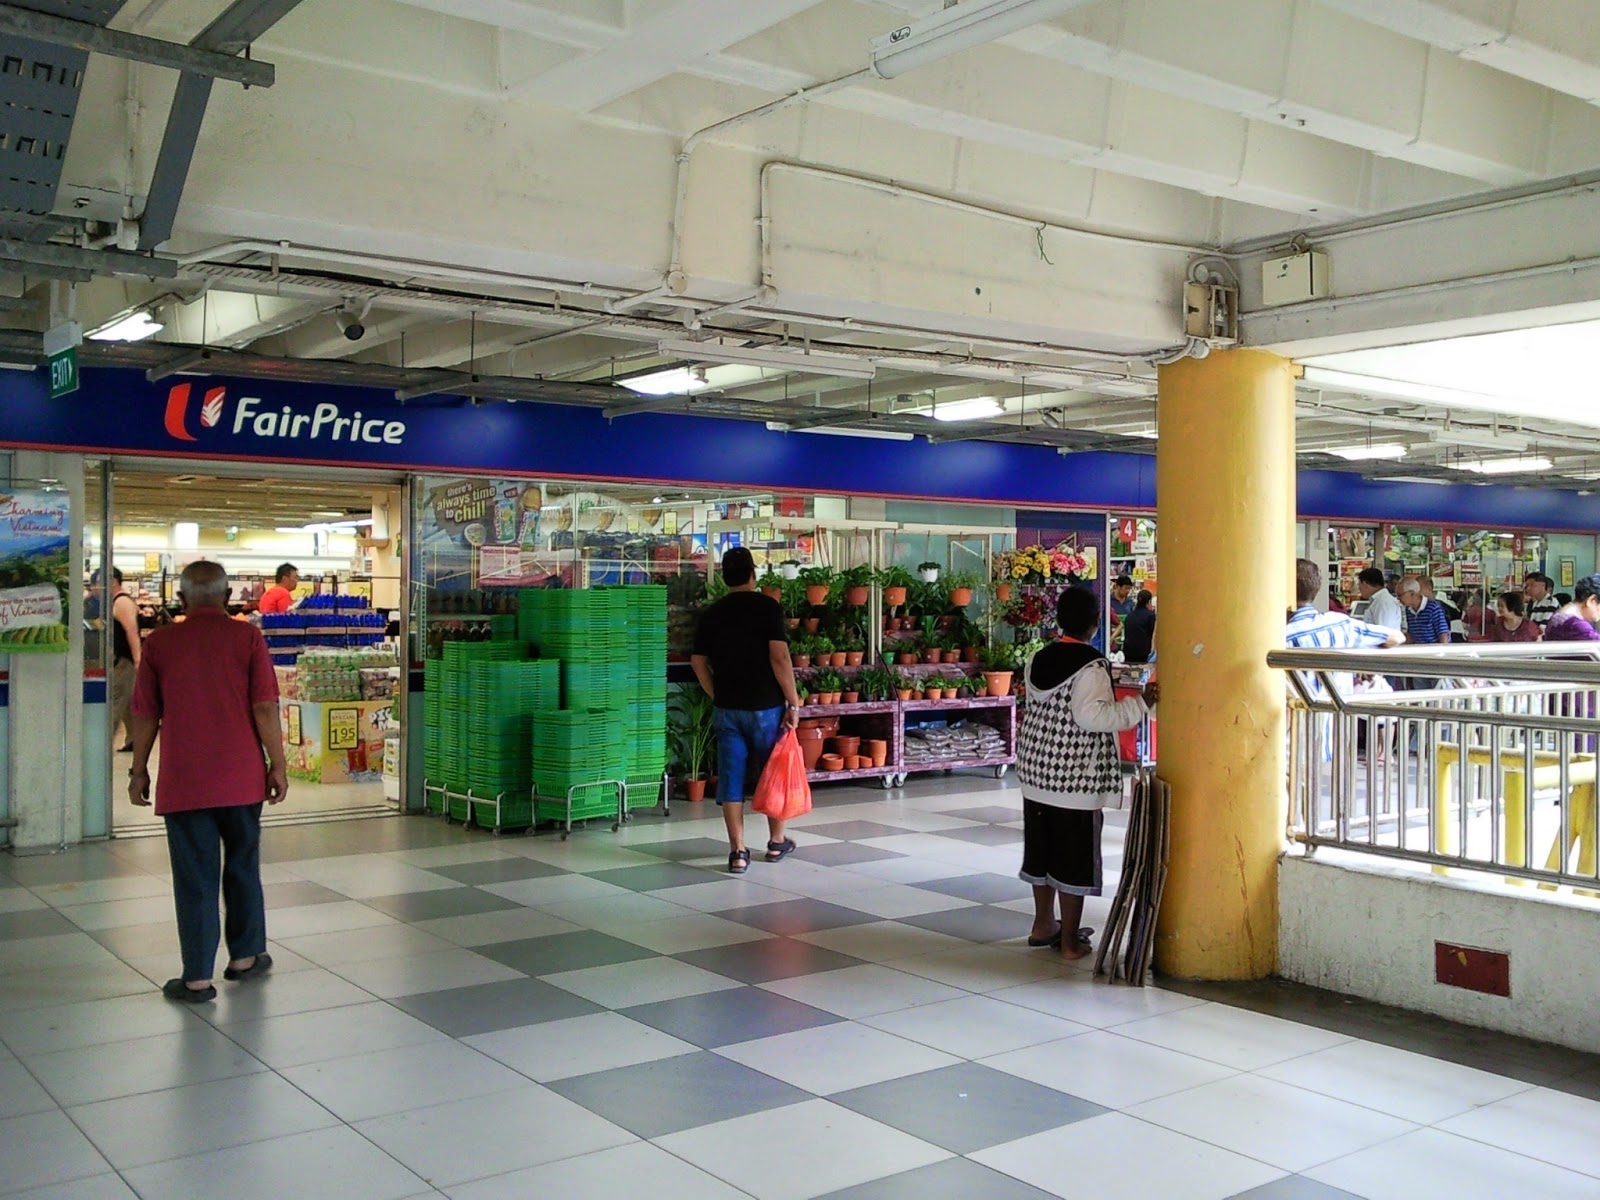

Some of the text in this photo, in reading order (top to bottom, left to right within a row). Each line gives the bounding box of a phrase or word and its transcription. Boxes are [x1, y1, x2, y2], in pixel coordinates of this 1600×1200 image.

[52, 357, 68, 390] EXIT
[232, 396, 406, 445] FairPrice
[437, 486, 496, 511] always time
[447, 483, 472, 497] there's
[0, 501, 64, 526] Charming
[445, 509, 454, 519] to
[454, 500, 485, 523] chill
[10, 516, 62, 531] Vietnam
[1124, 520, 1132, 537] 4
[1445, 535, 1451, 549] 8
[1515, 538, 1521, 551] 9
[10, 603, 53, 618] Vietnam
